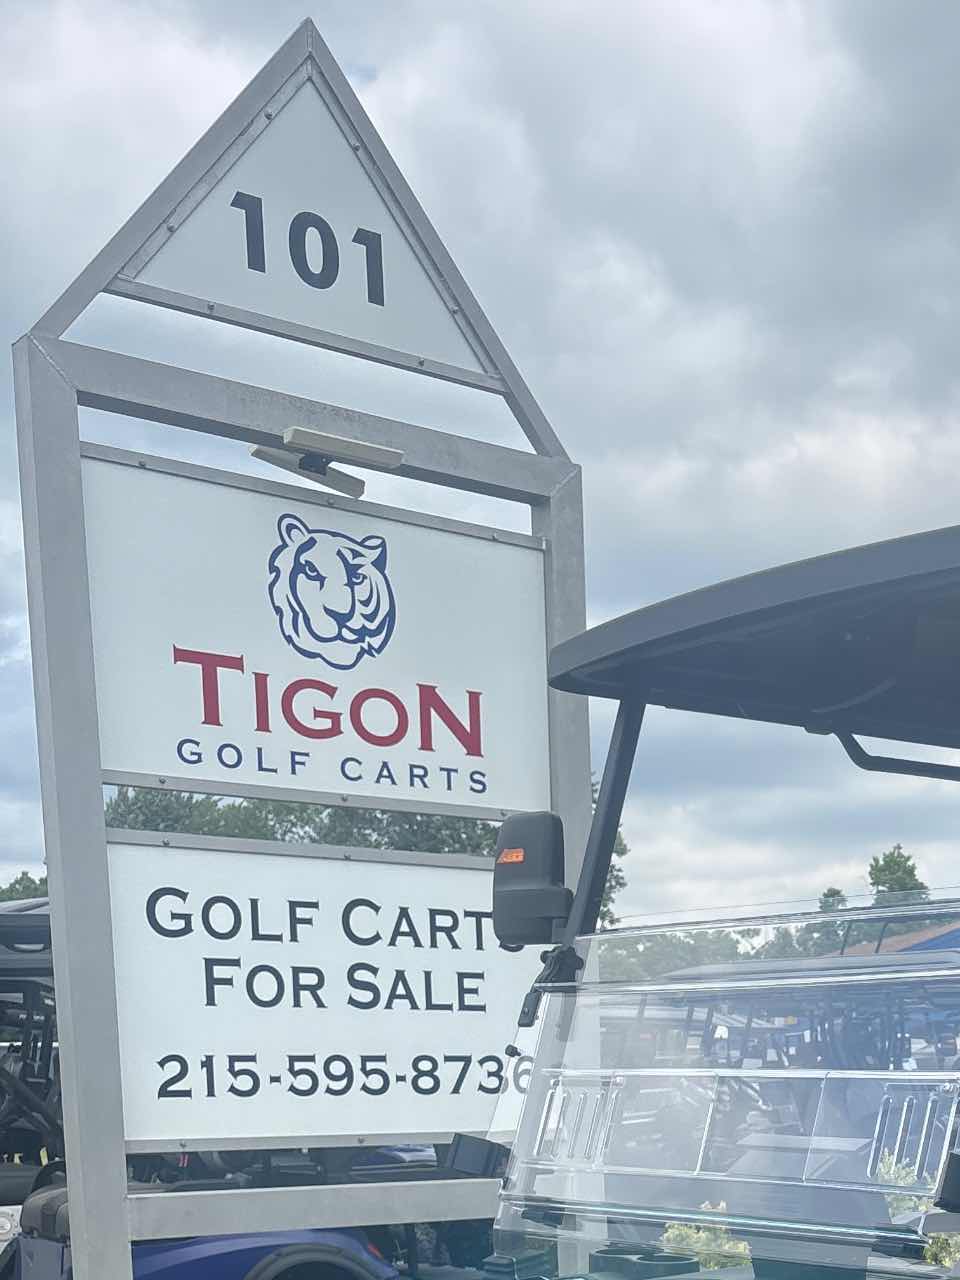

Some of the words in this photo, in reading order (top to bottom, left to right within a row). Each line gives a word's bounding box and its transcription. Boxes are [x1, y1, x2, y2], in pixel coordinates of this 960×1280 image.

[230, 190, 385, 307] 101
[173, 643, 484, 758] TIGON
[176, 738, 310, 776] GOLF
[340, 757, 488, 794] CARTS
[145, 886, 320, 943] GOLF
[341, 897, 525, 952] CART
[202, 957, 328, 1009] FOR
[346, 962, 487, 1013] SALE
